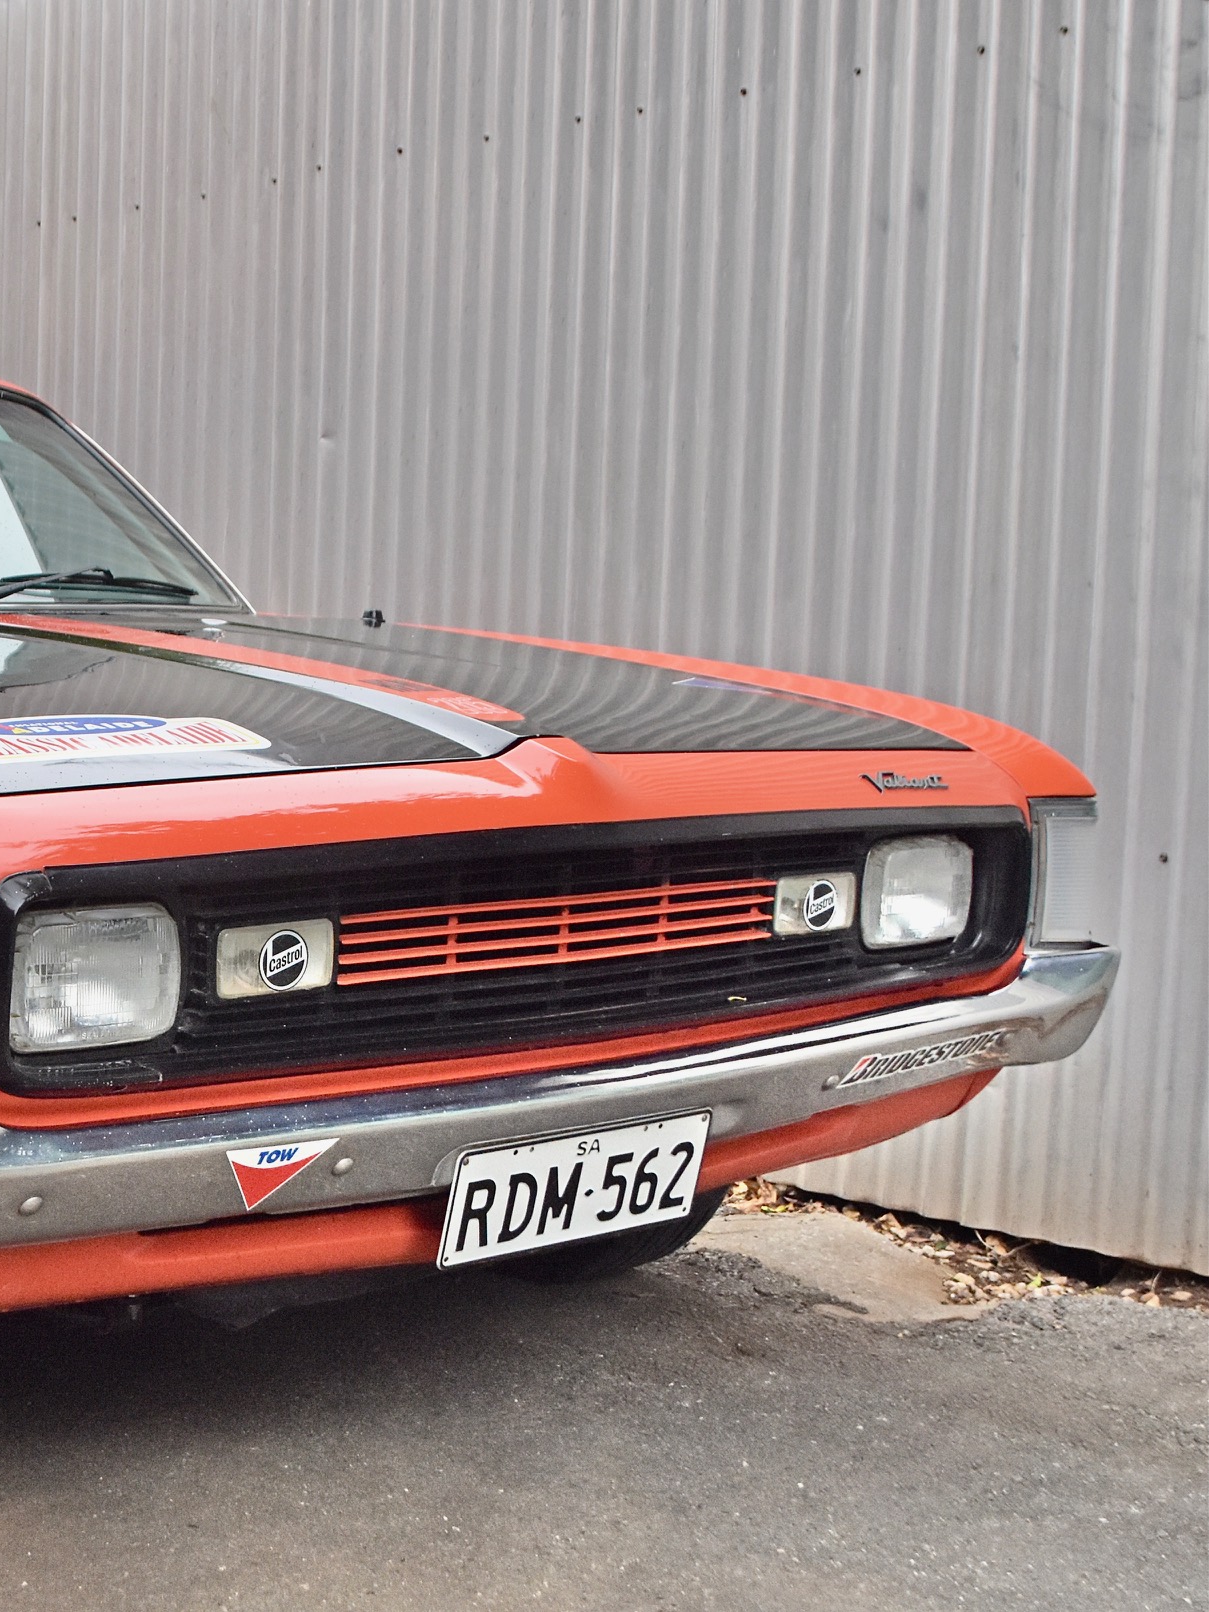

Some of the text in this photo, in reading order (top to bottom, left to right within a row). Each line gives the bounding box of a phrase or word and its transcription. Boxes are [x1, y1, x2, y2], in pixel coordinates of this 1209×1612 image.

[10, 720, 156, 735] ADELAIDE
[859, 771, 949, 794] Valiant
[809, 894, 836, 916] Castrol
[268, 945, 303, 973] Castrol
[841, 1028, 1004, 1086] BRIDGESTONE
[256, 1147, 299, 1165] TOW
[576, 1139, 601, 1157] SA
